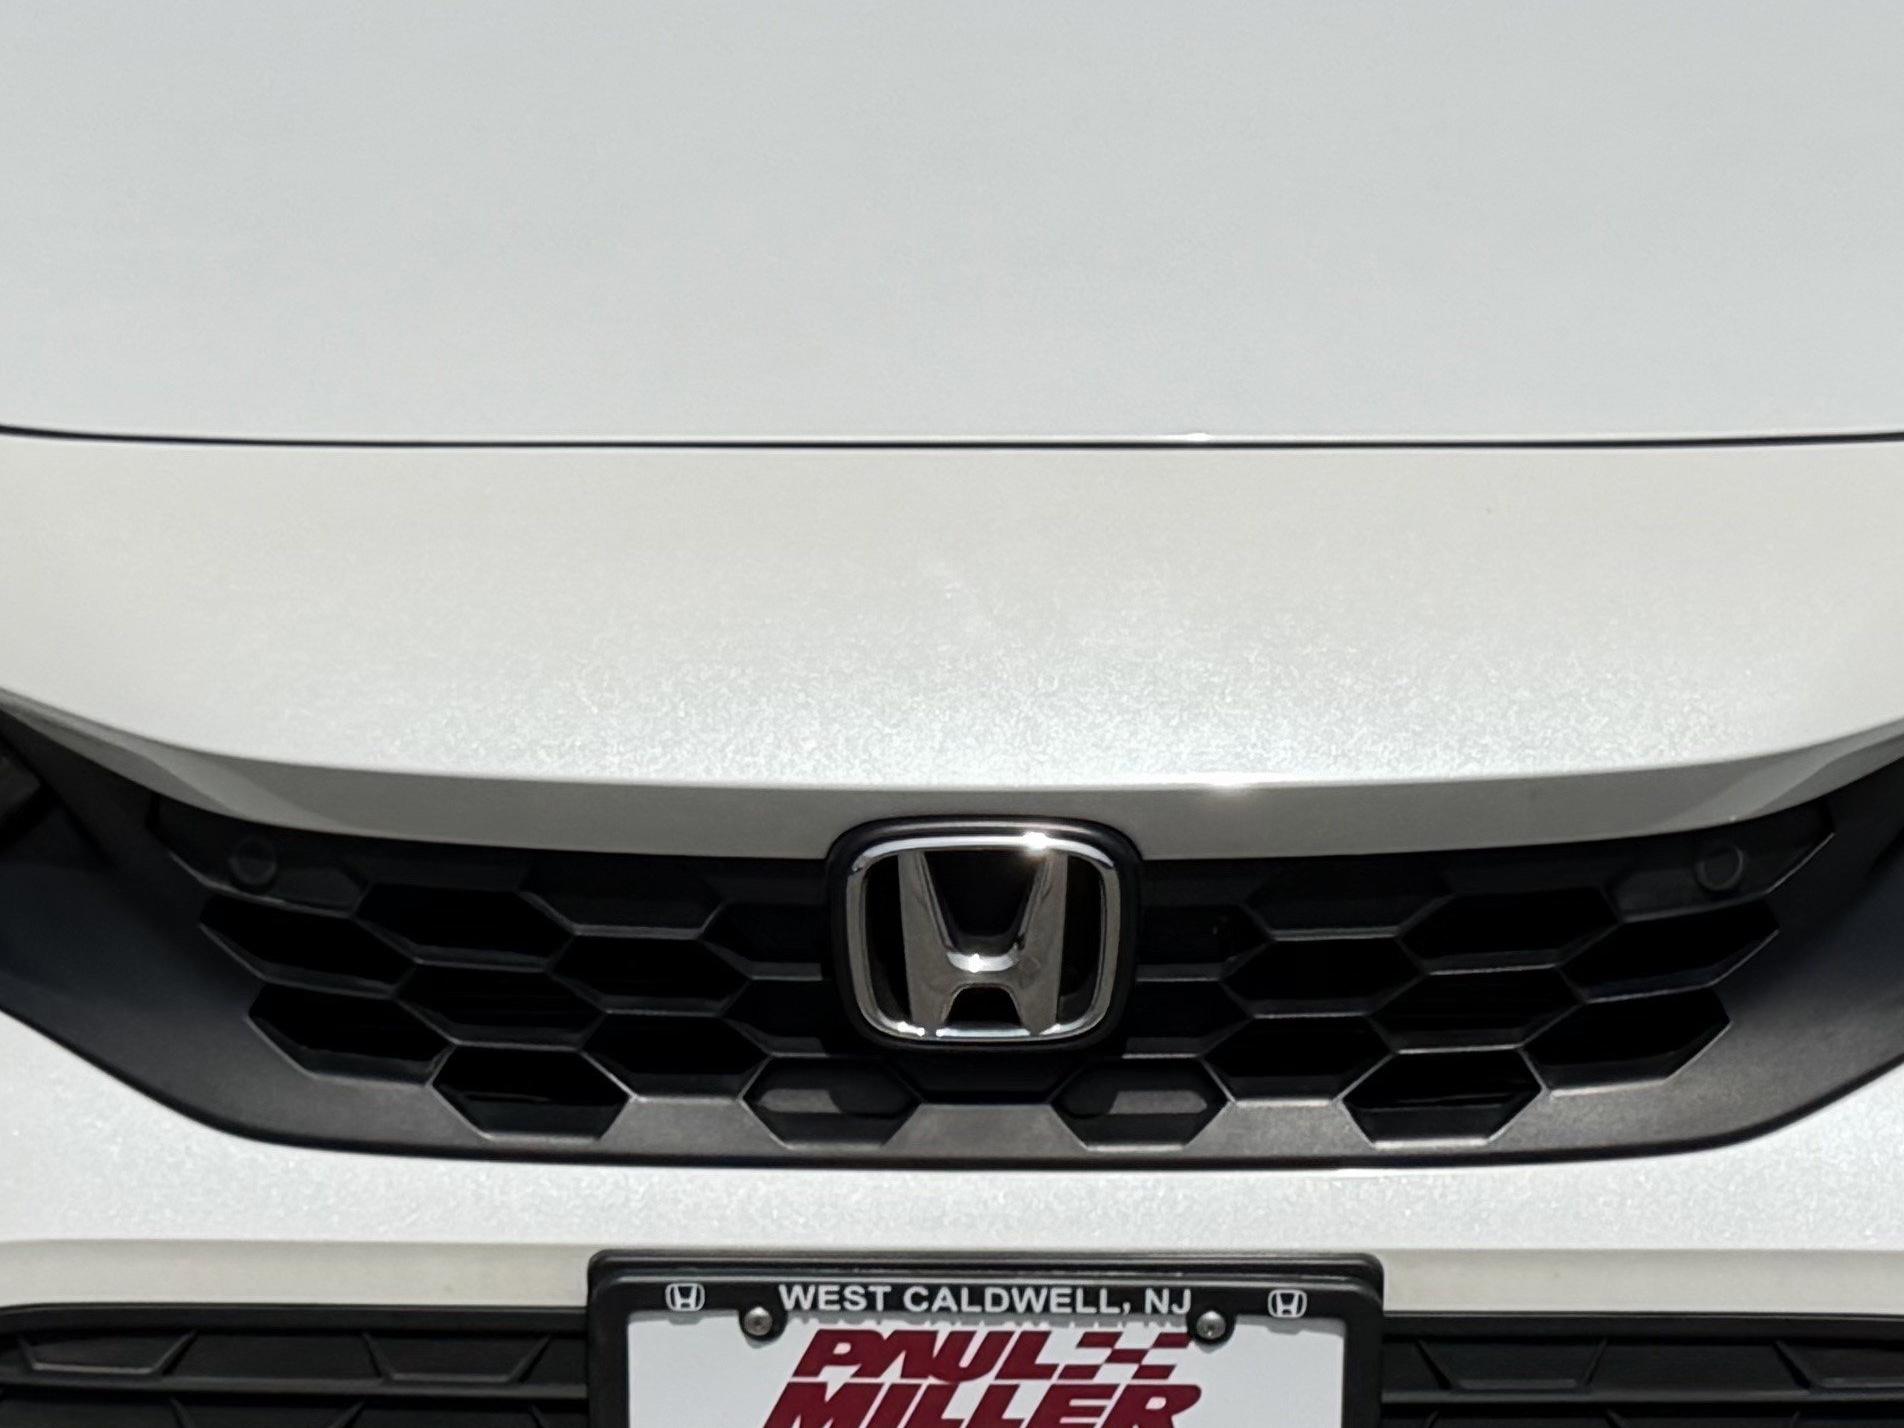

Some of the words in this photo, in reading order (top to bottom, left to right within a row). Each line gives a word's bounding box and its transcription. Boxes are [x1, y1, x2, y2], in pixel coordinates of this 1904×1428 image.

[778, 1284, 892, 1311] WEST
[902, 1286, 1132, 1315] CALDWELL,
[1145, 1288, 1192, 1315] NJ
[791, 1328, 1061, 1384] PAUL
